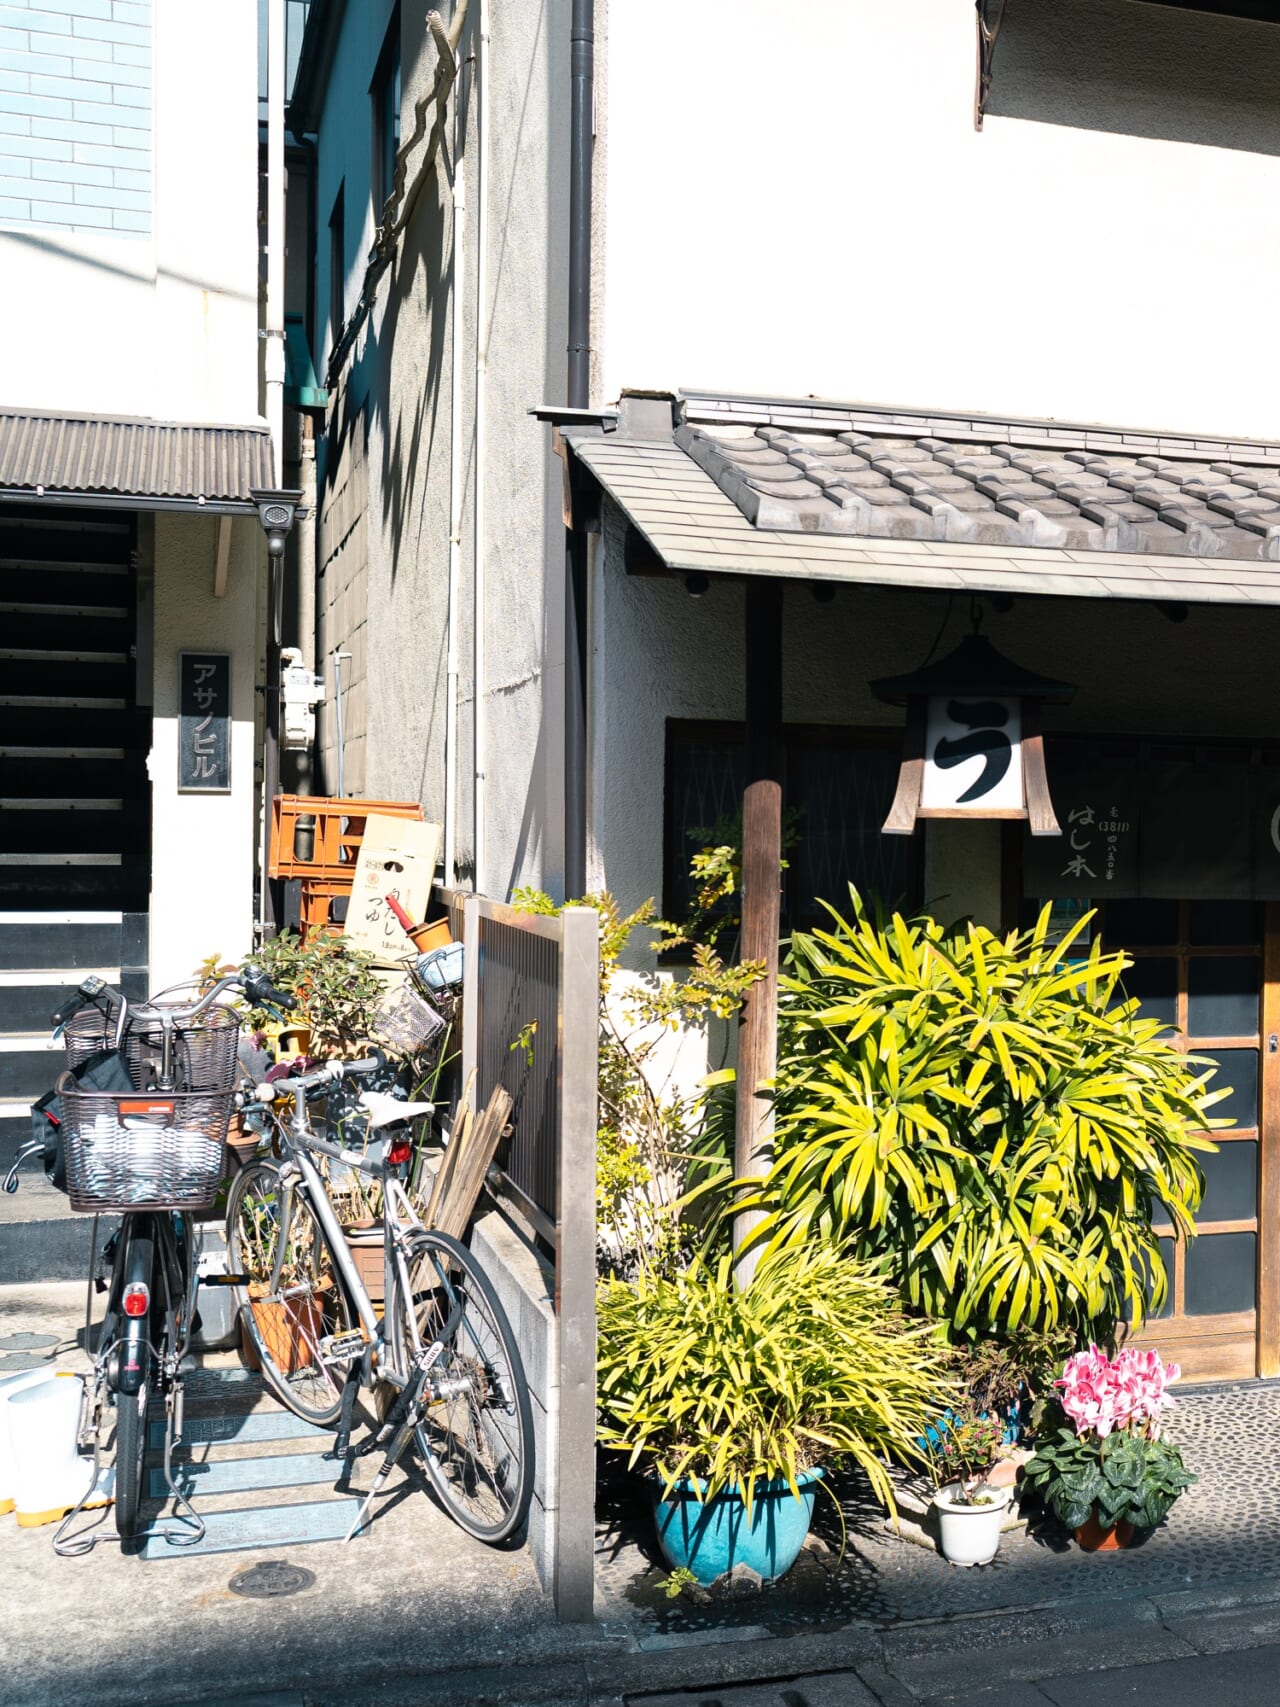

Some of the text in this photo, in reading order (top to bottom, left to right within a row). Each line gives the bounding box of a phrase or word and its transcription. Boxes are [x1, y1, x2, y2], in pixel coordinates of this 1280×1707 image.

[193, 664, 217, 778] アサノビル
[934, 700, 1012, 803] う
[1060, 804, 1097, 878] はし本
[365, 897, 383, 923] つゆ
